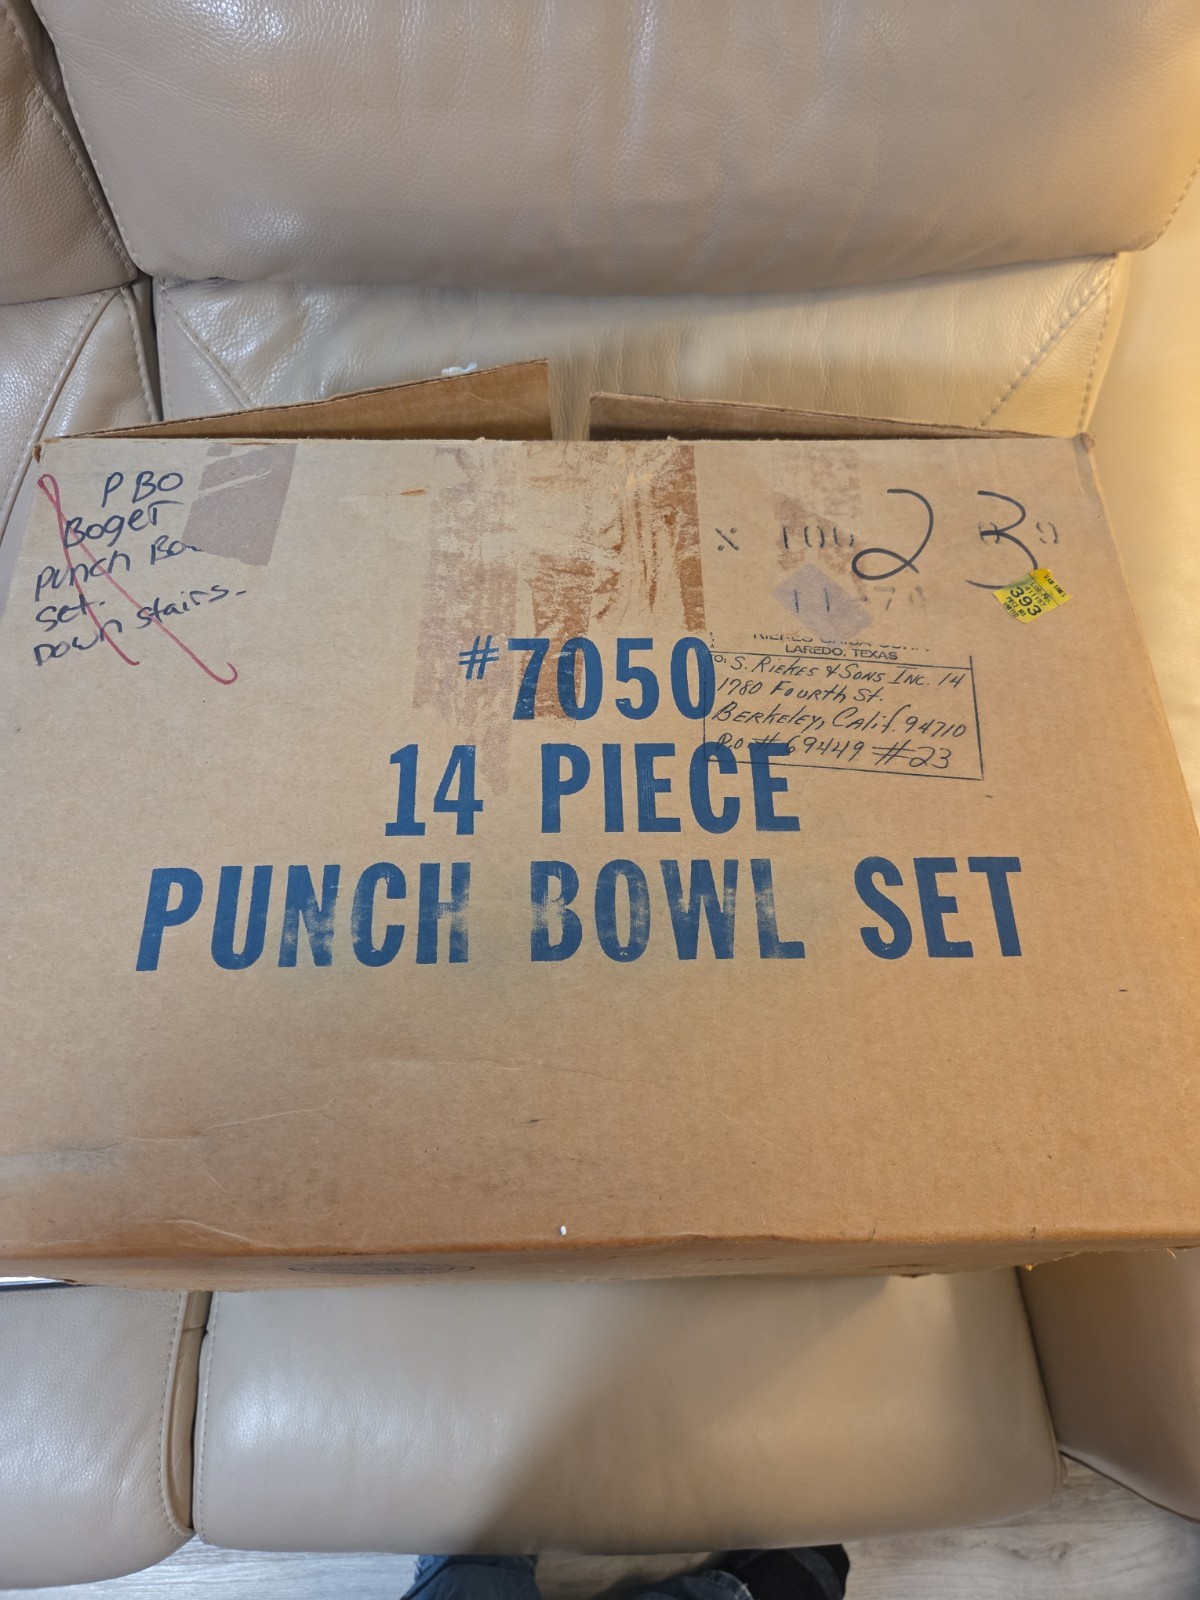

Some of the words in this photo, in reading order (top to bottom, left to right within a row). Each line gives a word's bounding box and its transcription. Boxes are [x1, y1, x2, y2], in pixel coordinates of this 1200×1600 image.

[1009, 586, 1042, 616] 393
[785, 644, 846, 657] LAREDO,
[853, 648, 899, 661] TEXAS
[716, 677, 764, 696] 1780
[904, 716, 967, 738] 94710
[384, 743, 484, 837] 14
[540, 741, 801, 835] PIECE
[136, 860, 471, 973] PUNCH
[530, 858, 806, 963] BOWL
[854, 855, 1022, 961] SET
